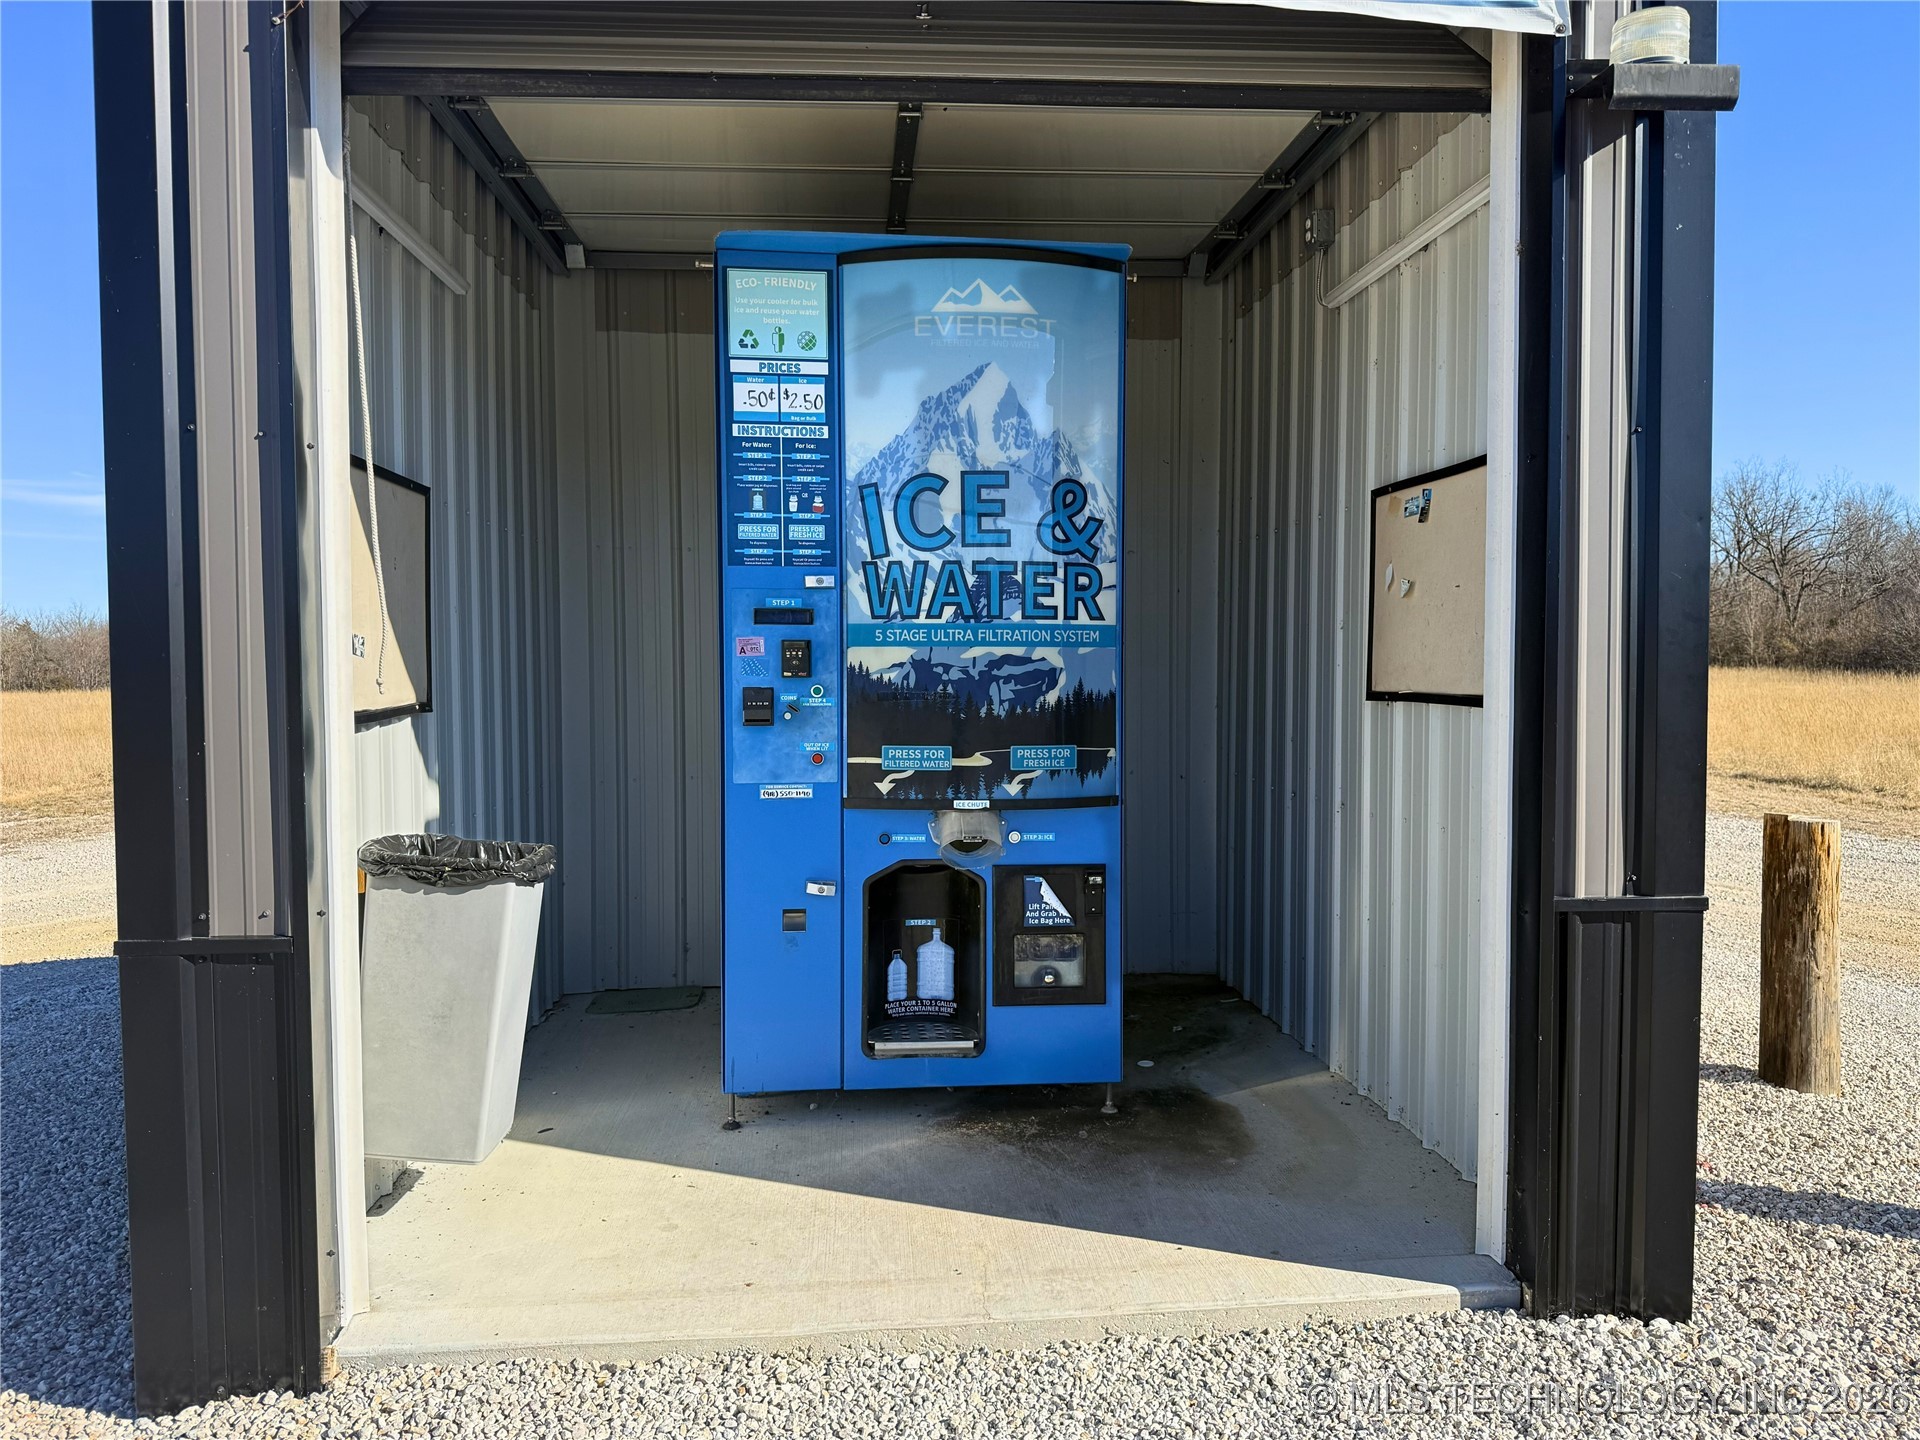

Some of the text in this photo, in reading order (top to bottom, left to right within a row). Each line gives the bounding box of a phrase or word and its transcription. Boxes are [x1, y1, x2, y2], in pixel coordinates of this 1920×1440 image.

[735, 277, 817, 291] ECO- FRIENDLY
[749, 298, 765, 306] your
[763, 317, 791, 325] bottles.
[914, 315, 1057, 339] EVEREST
[758, 362, 801, 373] PRICES
[783, 388, 824, 410] $2.50
[737, 425, 825, 437] INSTRUCTIONS
[858, 470, 1104, 563] ICE &
[861, 559, 1106, 621] WATER
[875, 629, 1100, 642] 5 STAGE ULTRA FILTRATION SYSTEM
[739, 647, 747, 655] A
[888, 749, 945, 759] PRESS FOR
[1017, 749, 1071, 758] PRESS FOR
[884, 760, 950, 768] FILTERED WATER
[1023, 759, 1065, 767] FRESH ICE
[885, 1001, 900, 1009] PLACE
[936, 1001, 957, 1009] GALLON
